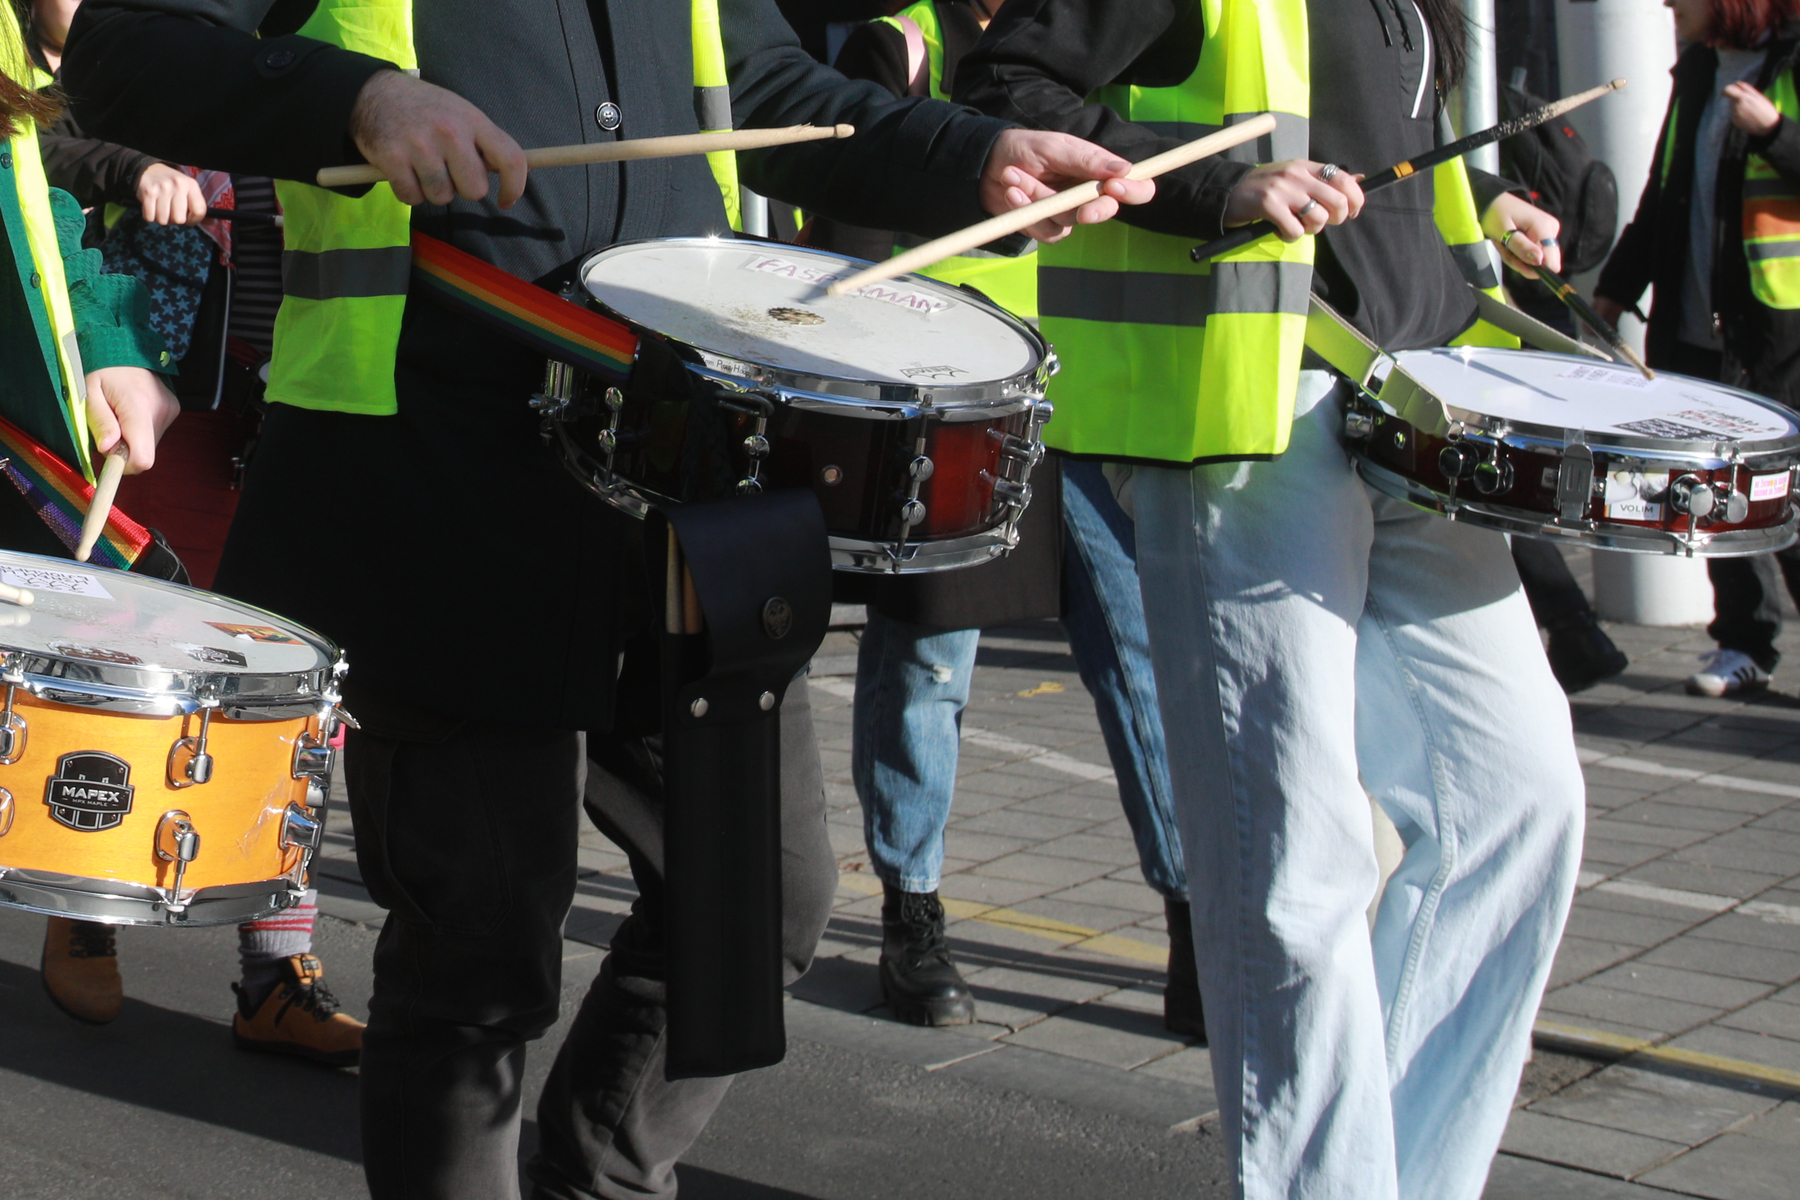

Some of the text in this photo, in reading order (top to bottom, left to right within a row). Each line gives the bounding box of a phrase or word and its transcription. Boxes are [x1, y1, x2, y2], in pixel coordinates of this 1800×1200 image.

[756, 258, 942, 314] FASPMAN
[1620, 504, 1654, 514] VOLIM
[62, 785, 120, 803] MAPEX
